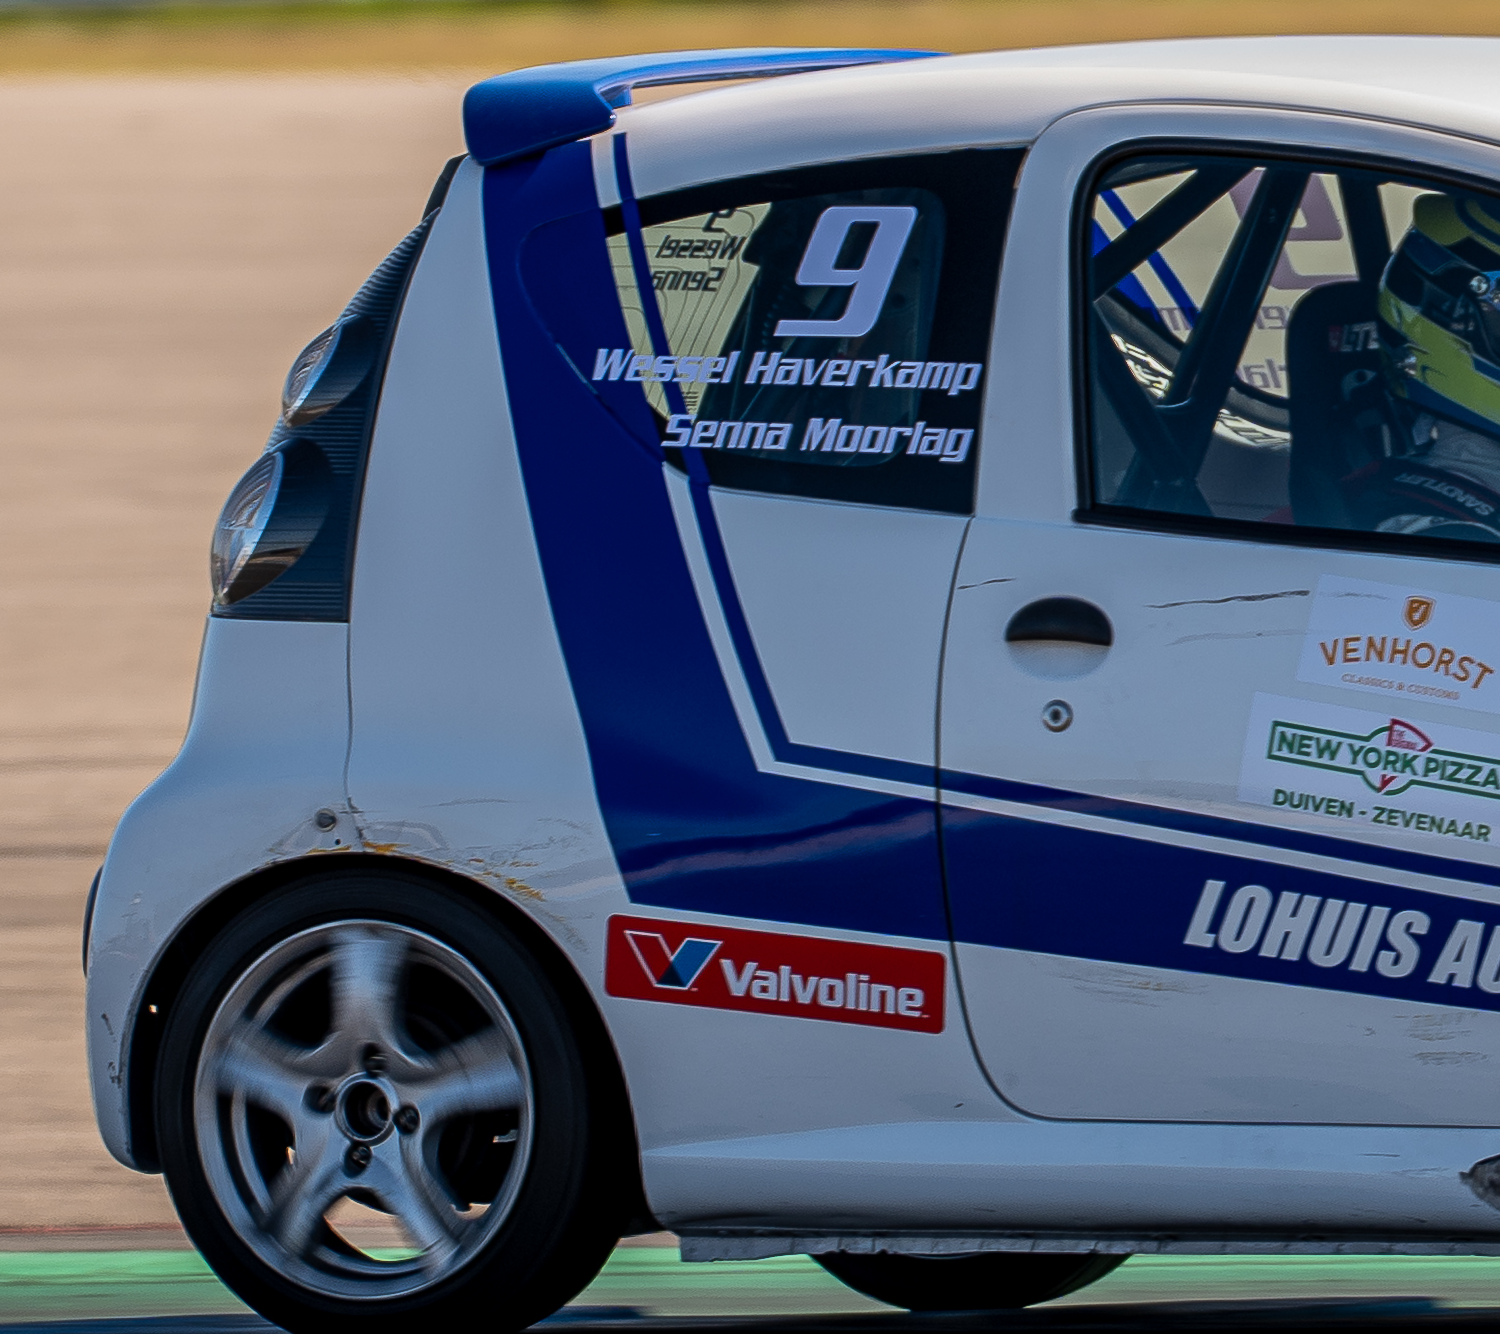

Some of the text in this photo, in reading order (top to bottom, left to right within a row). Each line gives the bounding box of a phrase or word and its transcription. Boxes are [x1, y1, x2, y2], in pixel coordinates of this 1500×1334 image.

[773, 205, 918, 337] 9
[592, 348, 983, 396] Wessel Haverkamp
[660, 413, 974, 463] Senna Moorlag
[1319, 635, 1495, 689] VENHORST
[1276, 730, 1343, 761] NEW
[1347, 742, 1419, 776] YORK
[1272, 788, 1355, 819] DUIVEN
[1370, 805, 1492, 843] ZEVENAAR
[1183, 878, 1431, 978] LOHUIS
[718, 958, 926, 1018] Valvoline
